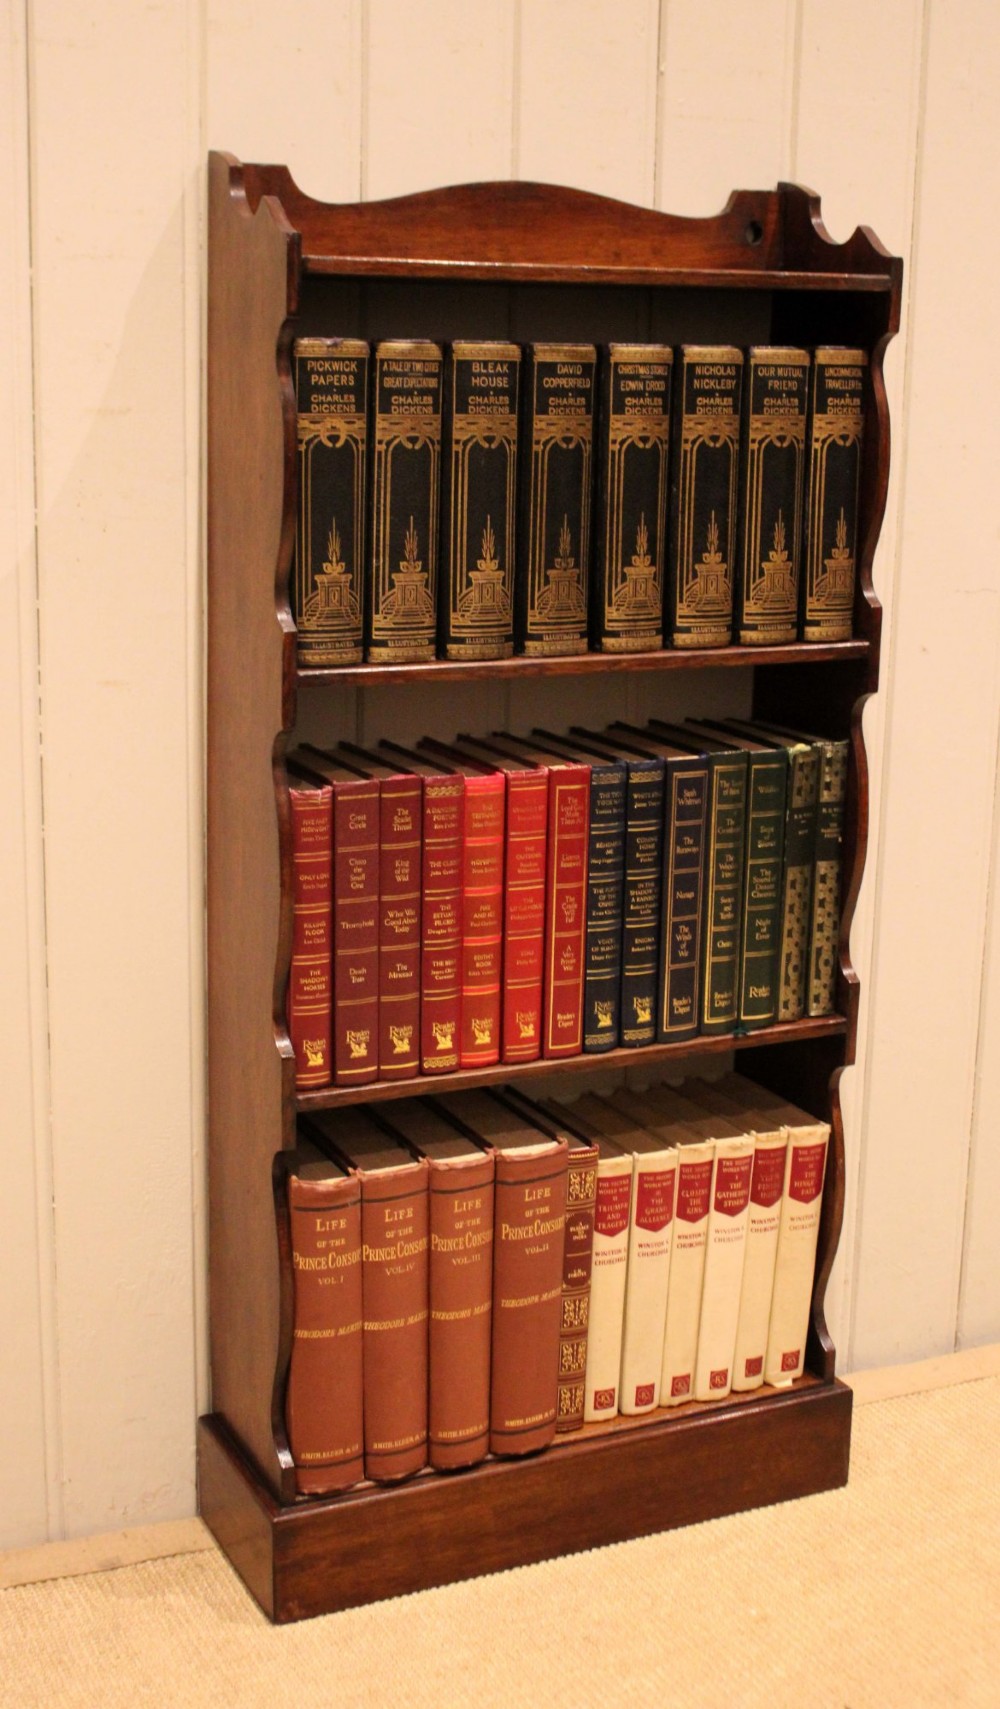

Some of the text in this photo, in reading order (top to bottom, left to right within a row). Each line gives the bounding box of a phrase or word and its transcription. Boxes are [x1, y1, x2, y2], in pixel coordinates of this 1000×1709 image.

[307, 360, 358, 372] PICKWICK
[383, 361, 388, 371] A
[389, 361, 403, 371] TALE
[472, 362, 509, 373] BLEAK
[557, 364, 582, 375] DAVID
[618, 364, 650, 375] CHRISTMAS
[695, 366, 736, 376] NICHOLAS
[757, 367, 803, 378] OUR MUTUAL
[311, 374, 355, 386] PAPERS
[384, 376, 403, 388] GREAT
[472, 377, 509, 387] HOUSE
[543, 377, 591, 388] COPPERFIELD
[693, 379, 736, 390] NICKLEBY
[768, 379, 798, 391] FRIEND
[620, 380, 666, 391] EDWIN DROOD
[311, 394, 355, 403] CHARLES
[391, 395, 433, 404] CHARLES
[468, 395, 509, 404] CHARLES
[548, 397, 586, 406] CHARLES
[625, 397, 663, 405] CHARLES
[696, 397, 733, 406] CHARLES
[763, 397, 799, 406] CHARLES
[827, 397, 861, 406] CHARLES
[311, 404, 356, 413] DICKENS
[391, 405, 433, 414] DICKENS
[468, 405, 510, 414] DICKENS
[548, 407, 586, 415] DICKENS
[625, 406, 663, 414] DICKENS
[696, 406, 733, 415] DICKENS
[763, 406, 799, 415] DICKENS
[827, 406, 861, 415] DICKENS
[598, 1203, 628, 1213] TRIUMPH
[723, 1199, 745, 1208] STORM
[525, 1205, 550, 1218] OF THE
[645, 1206, 668, 1214] GRAND
[606, 1213, 621, 1221] AND
[639, 1214, 670, 1223] ALLIANCE
[455, 1217, 481, 1230] OF THE
[597, 1220, 627, 1230] TRAGEDY
[385, 1226, 413, 1238] OF THE
[502, 1223, 534, 1241] PRINCE
[316, 1238, 346, 1248] OF THE
[431, 1233, 465, 1252] PRINCE
[638, 1241, 665, 1249] WINSTON
[363, 1244, 396, 1261] PRINCE
[594, 1248, 622, 1257] WINSTON
[293, 1251, 327, 1271] PRINCE
[406, 1262, 415, 1272] IV
[340, 1275, 344, 1283] I
